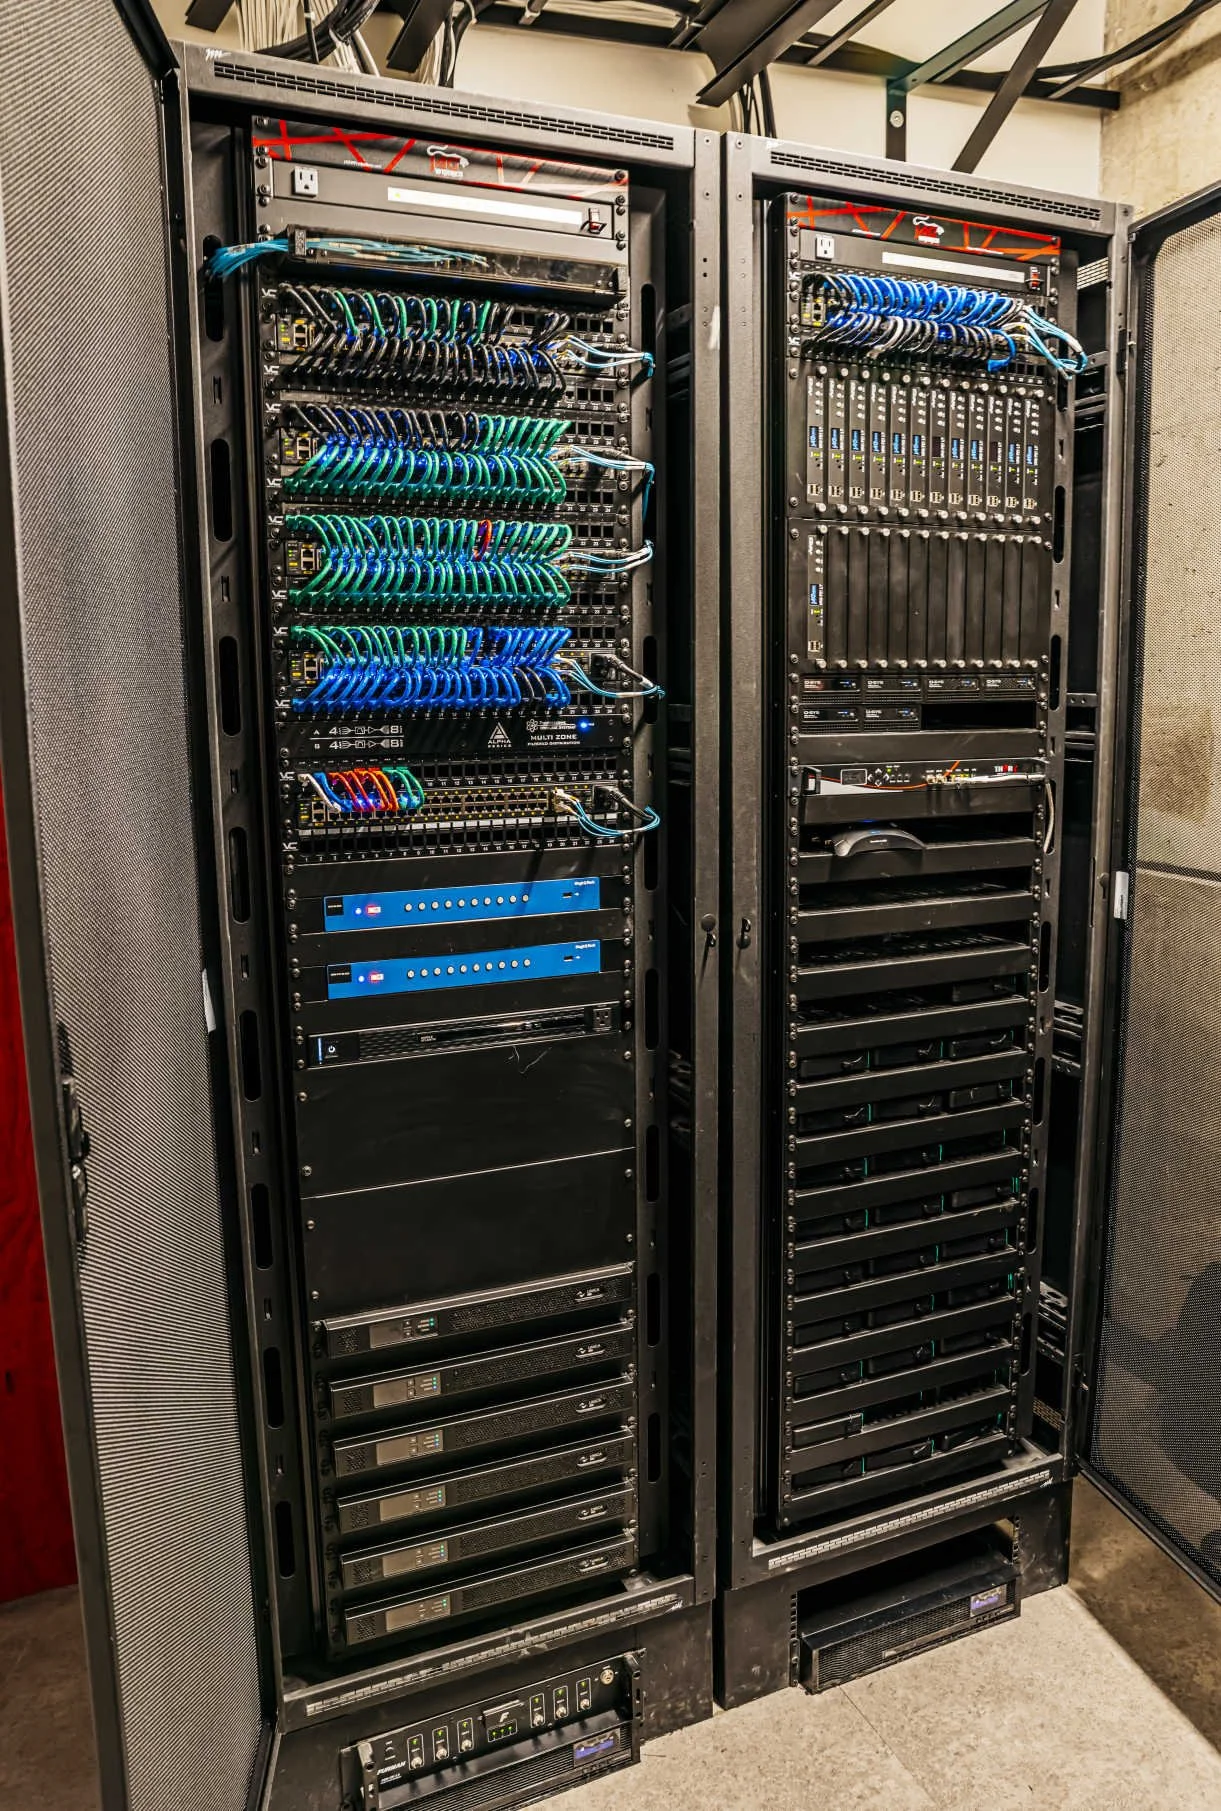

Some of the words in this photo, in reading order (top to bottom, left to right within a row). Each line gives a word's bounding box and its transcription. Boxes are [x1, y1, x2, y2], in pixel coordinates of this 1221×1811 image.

[329, 727, 339, 735] 4
[391, 725, 399, 734] 8
[329, 741, 339, 750] 4
[391, 739, 399, 748] 8
